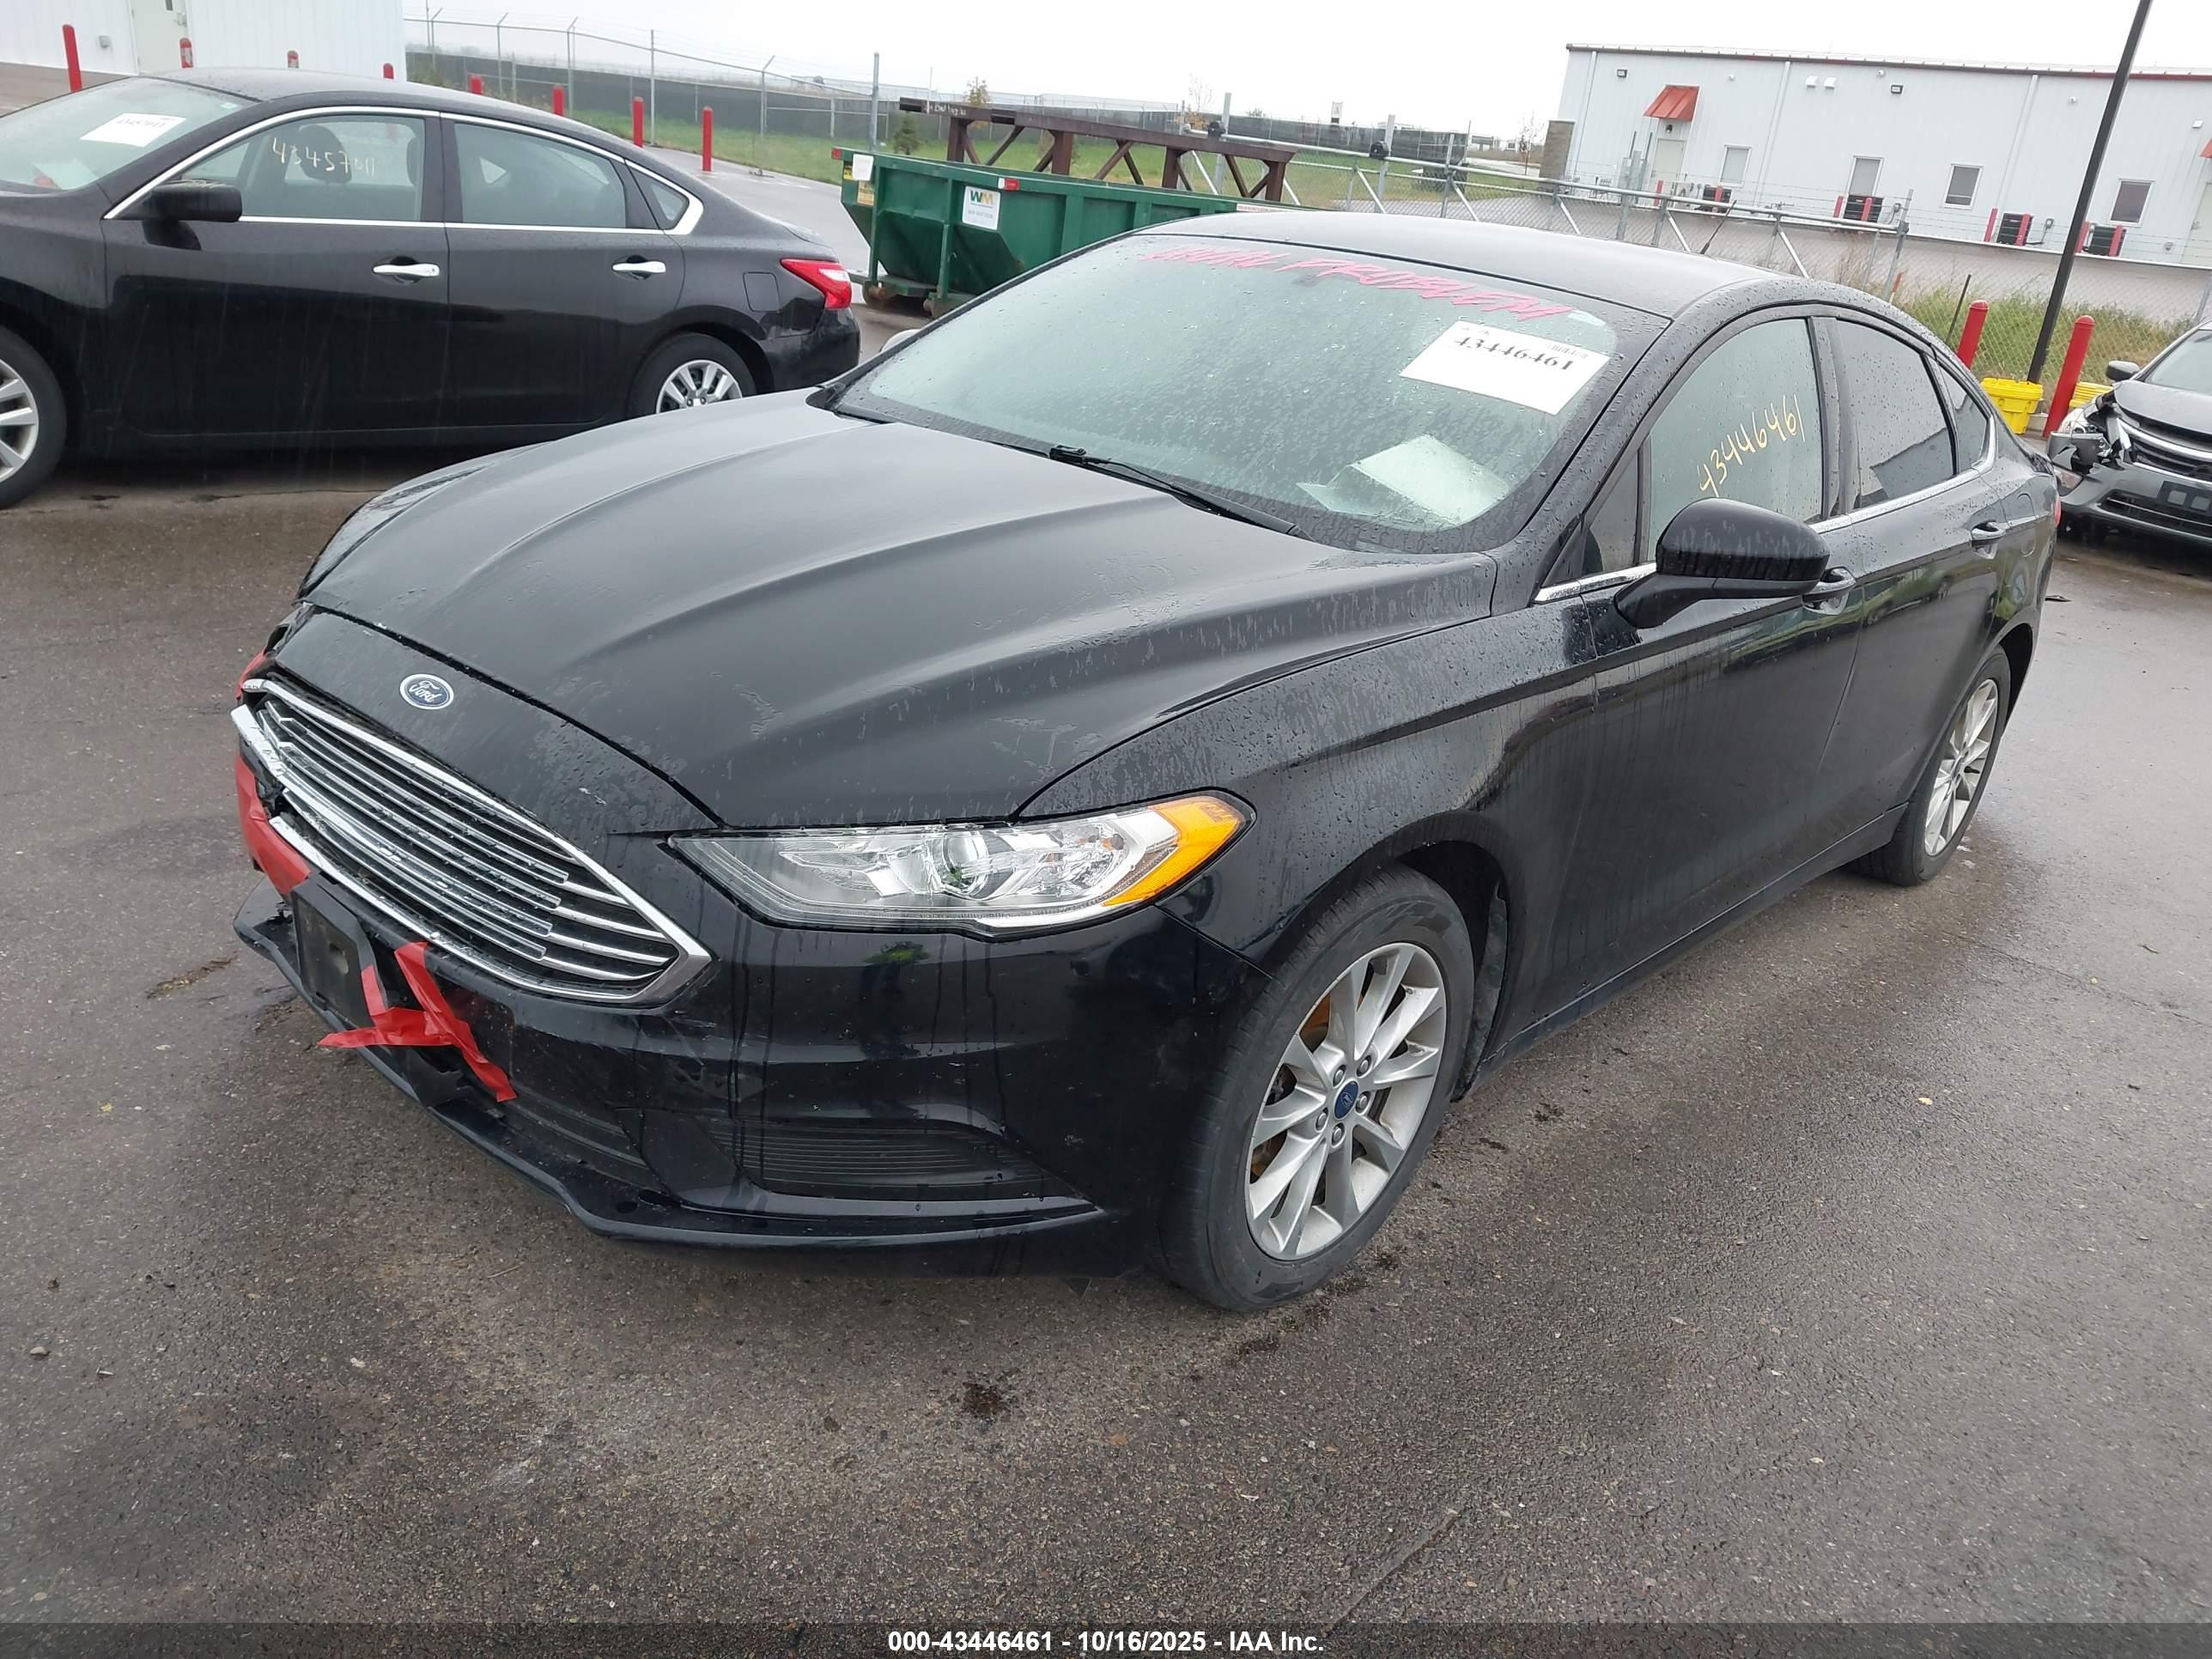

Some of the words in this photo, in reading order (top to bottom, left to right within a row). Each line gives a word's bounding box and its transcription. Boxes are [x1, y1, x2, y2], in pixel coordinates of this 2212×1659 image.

[969, 190, 994, 205] WM
[1454, 336, 1574, 370] 43446461
[1697, 394, 1806, 497] 43446461
[409, 680, 442, 702] Ford
